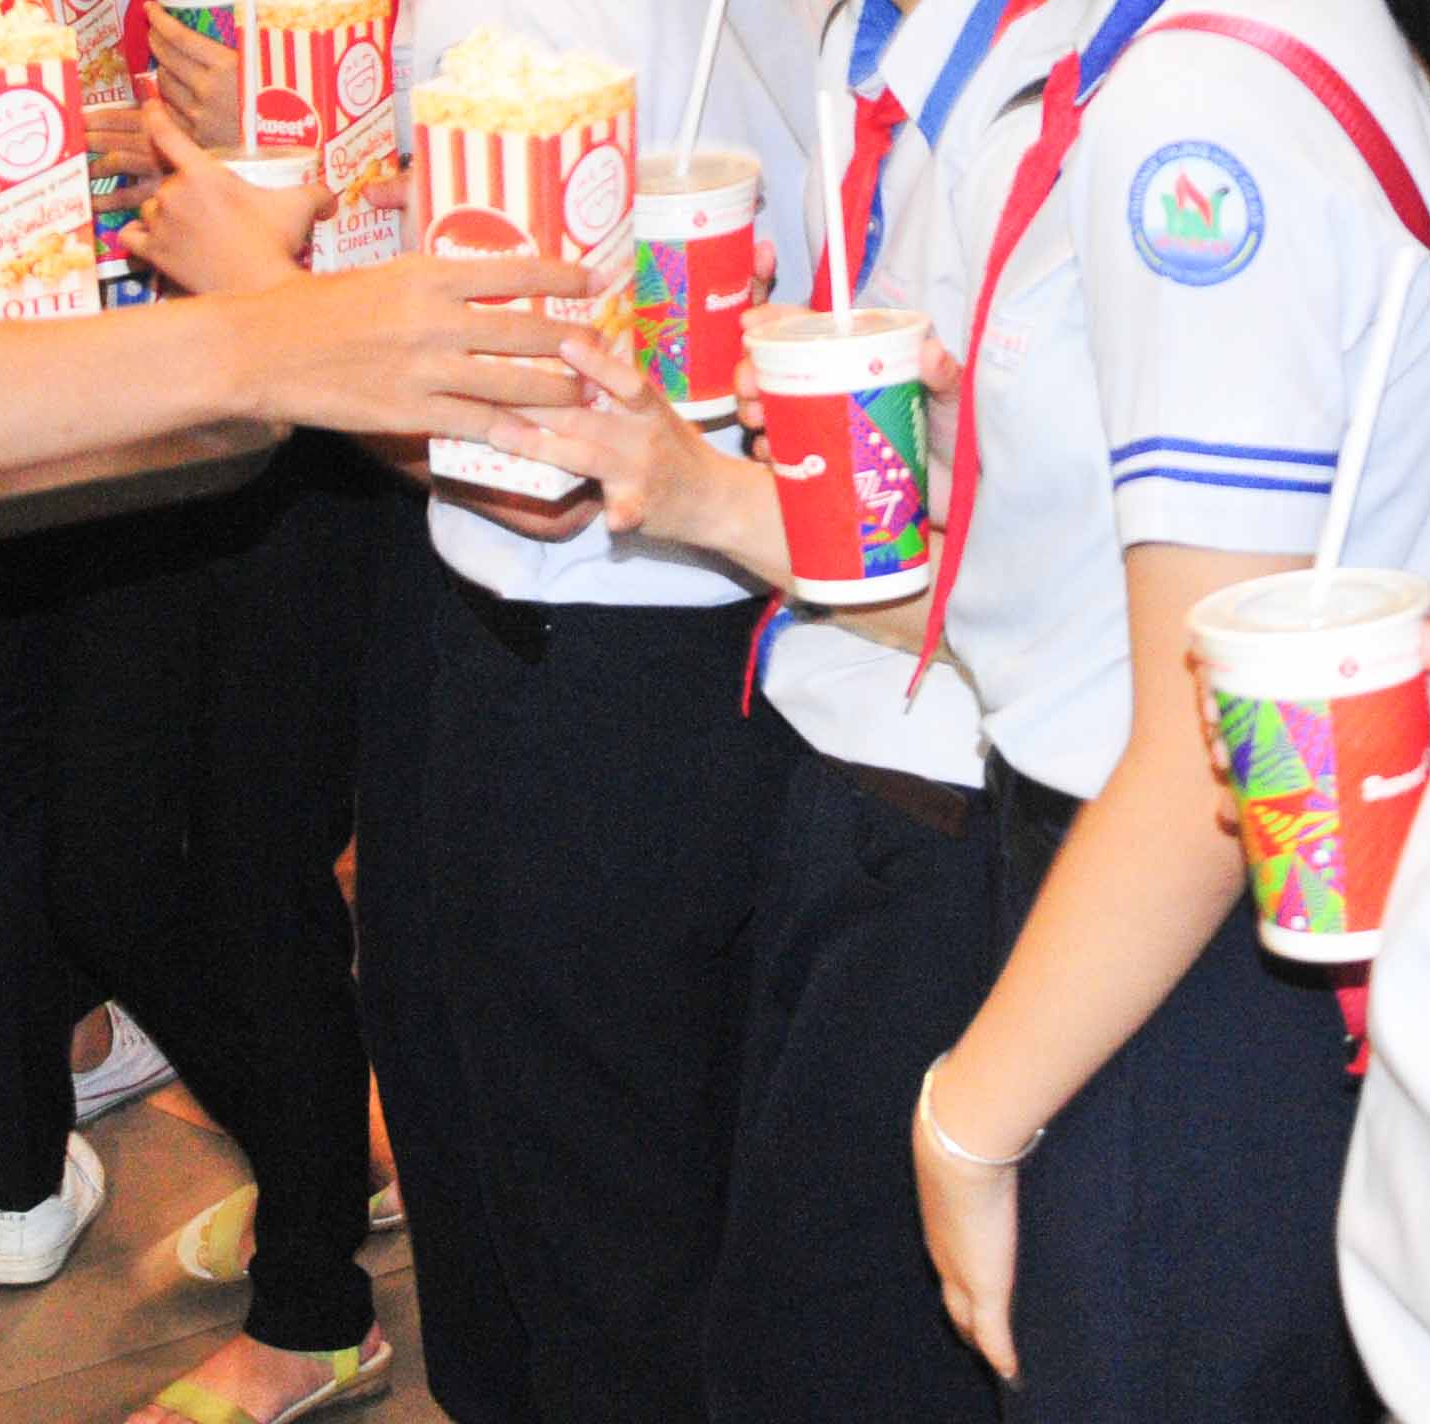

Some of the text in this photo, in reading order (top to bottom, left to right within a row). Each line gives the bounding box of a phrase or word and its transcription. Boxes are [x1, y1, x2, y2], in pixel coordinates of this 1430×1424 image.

[82, 86, 128, 107] OTTE
[337, 208, 393, 236] LOTTE
[337, 227, 395, 254] CINEMA
